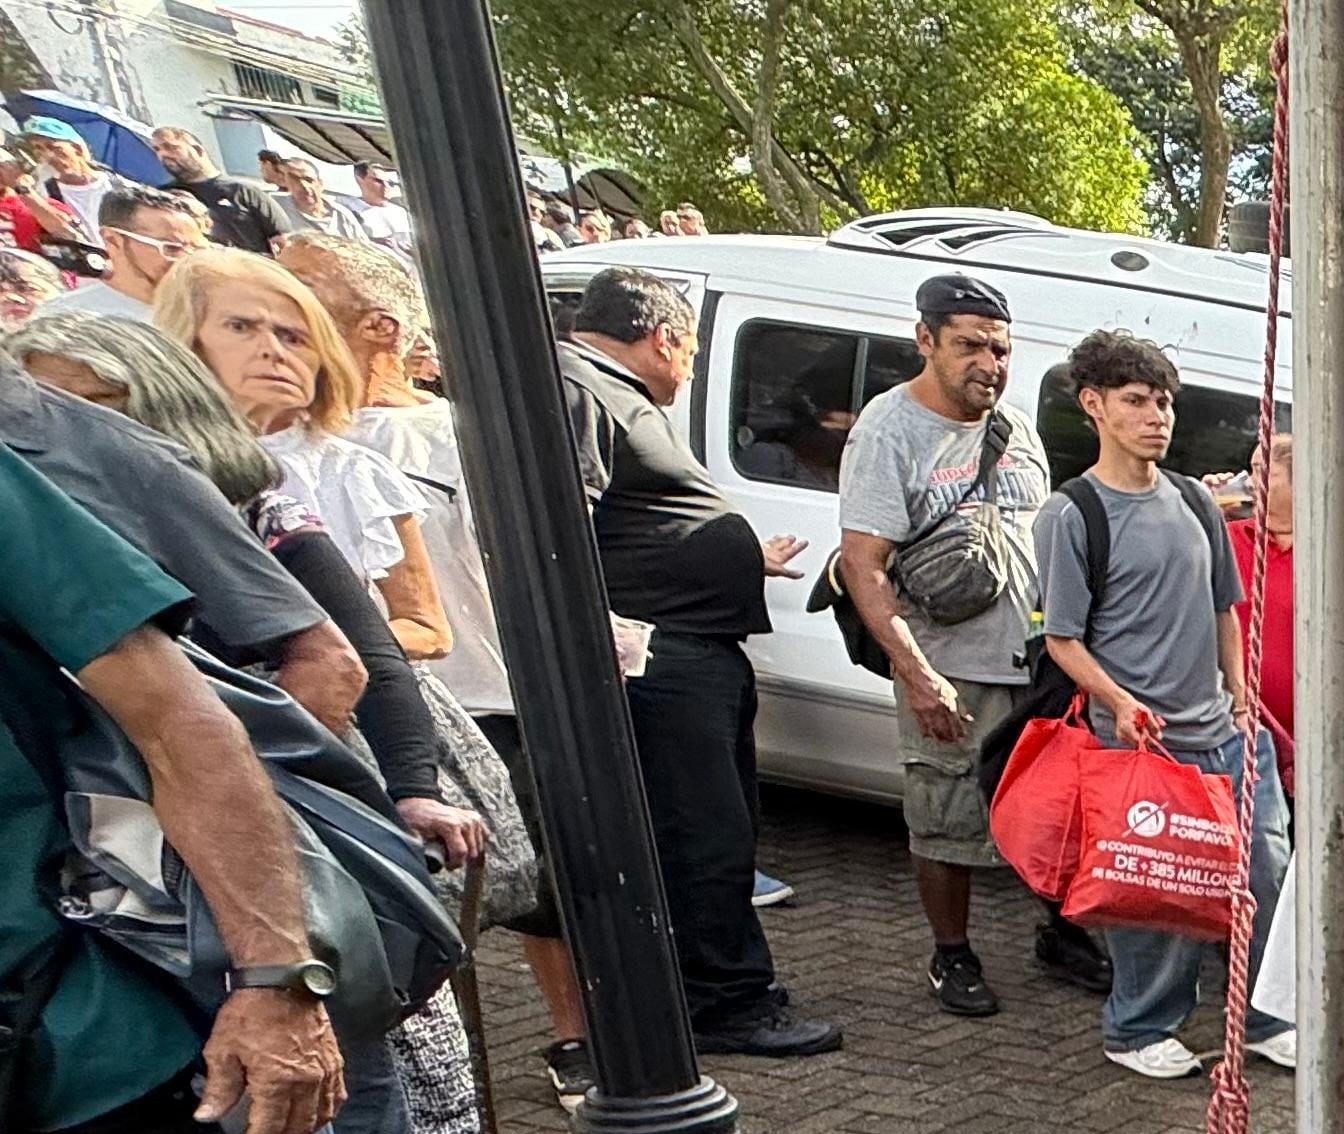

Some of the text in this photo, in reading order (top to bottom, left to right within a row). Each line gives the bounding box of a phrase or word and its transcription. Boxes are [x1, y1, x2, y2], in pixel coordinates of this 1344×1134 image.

[1107, 840, 1175, 863] CONTRIBUYO
[1114, 854, 1139, 873] DE
[1105, 869, 1146, 886] BOLSAS
[1146, 876, 1161, 890] DE
[1161, 880, 1178, 892] UN
[1178, 883, 1205, 897] SOLO
